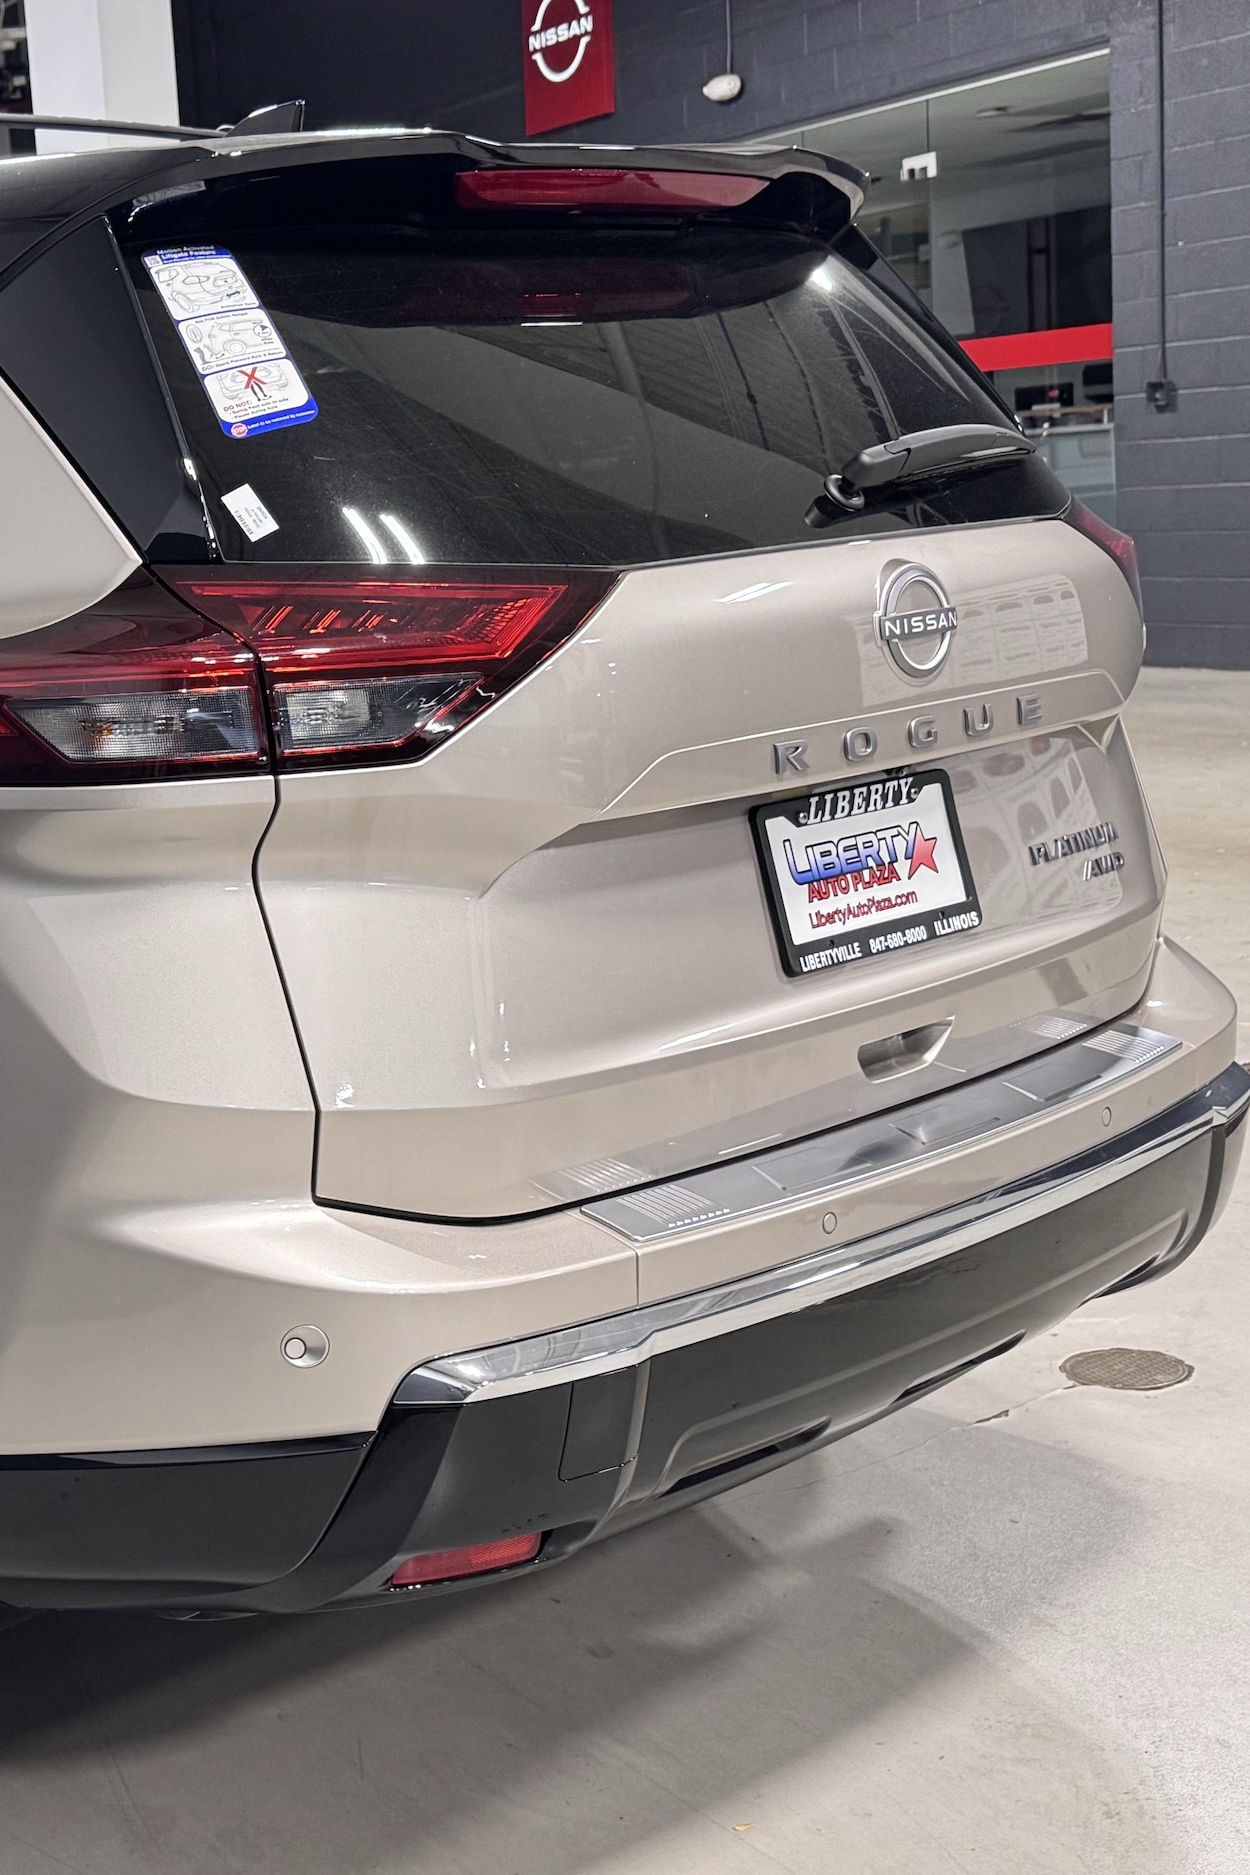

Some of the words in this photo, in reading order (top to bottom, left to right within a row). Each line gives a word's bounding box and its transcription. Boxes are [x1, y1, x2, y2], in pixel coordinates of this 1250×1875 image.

[529, 15, 593, 52] NISSAN
[223, 404, 235, 412] DO
[884, 611, 957, 637] NISSAN
[773, 693, 1043, 775] ROGUE
[806, 777, 914, 824] LIBERTY
[783, 821, 919, 885] LIBERTY
[1028, 822, 1119, 866] PLATINUM
[808, 874, 851, 903] AUTO
[852, 862, 901, 891] PLAZA
[808, 891, 918, 928] LibertyAutoPlaza.com
[799, 942, 862, 973] LIBERTYVILLE
[869, 925, 927, 954] 847-680-8000
[933, 911, 979, 936] ILLINOIS
